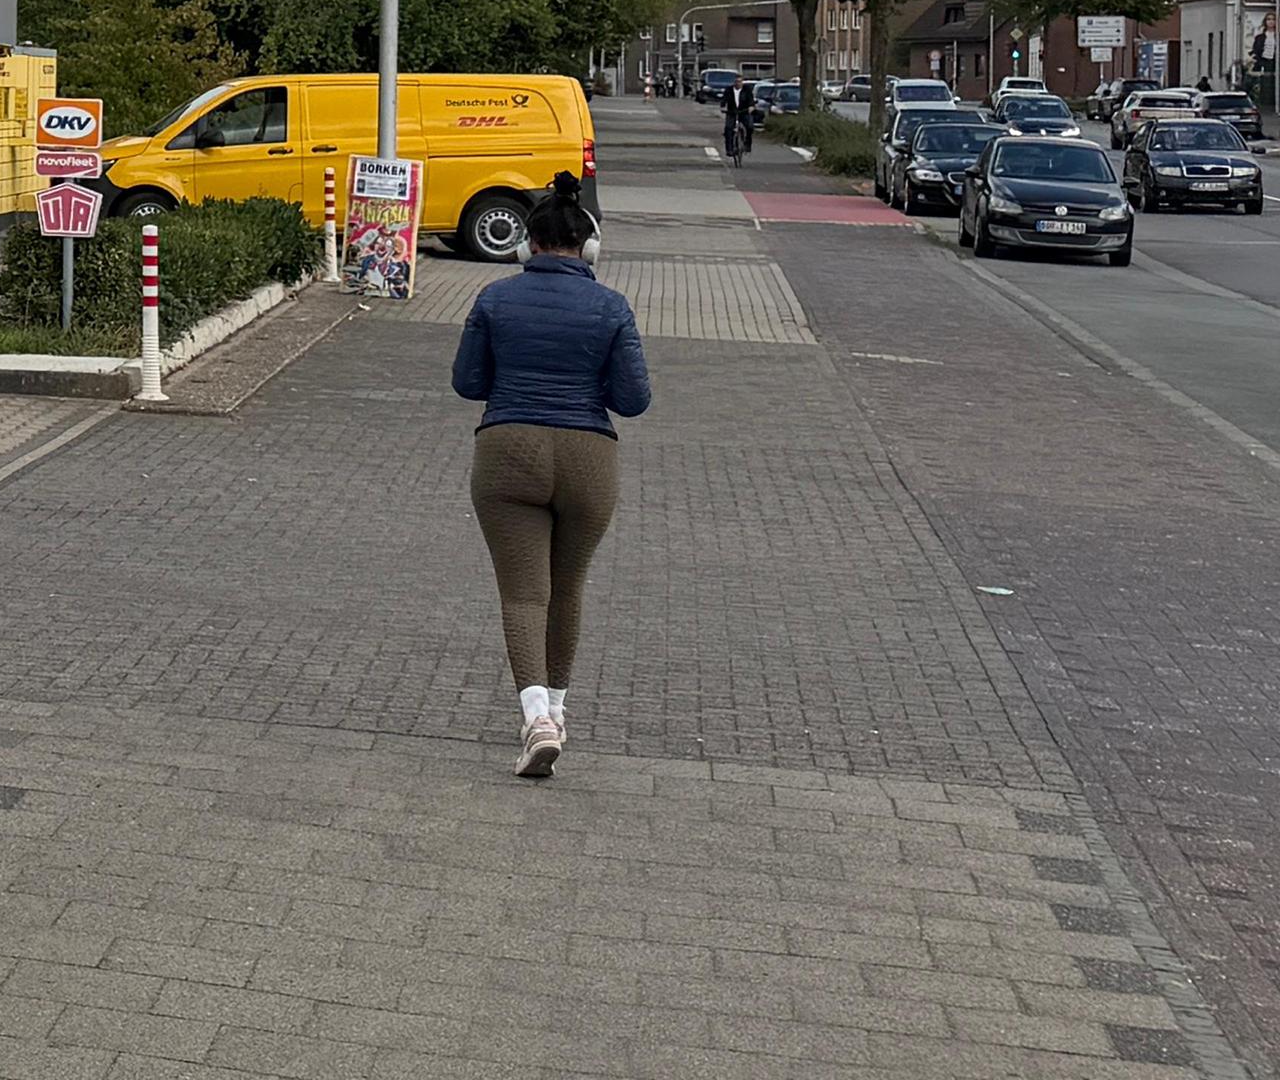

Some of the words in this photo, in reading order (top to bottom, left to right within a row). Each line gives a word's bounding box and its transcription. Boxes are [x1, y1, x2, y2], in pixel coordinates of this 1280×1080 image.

[445, 99, 486, 107] Deutsche
[488, 99, 508, 107] Post
[44, 114, 92, 131] DKV
[458, 116, 509, 127] DHL
[38, 156, 95, 167] novofleet
[359, 162, 407, 176] BORKEN
[40, 187, 96, 232] UTA
